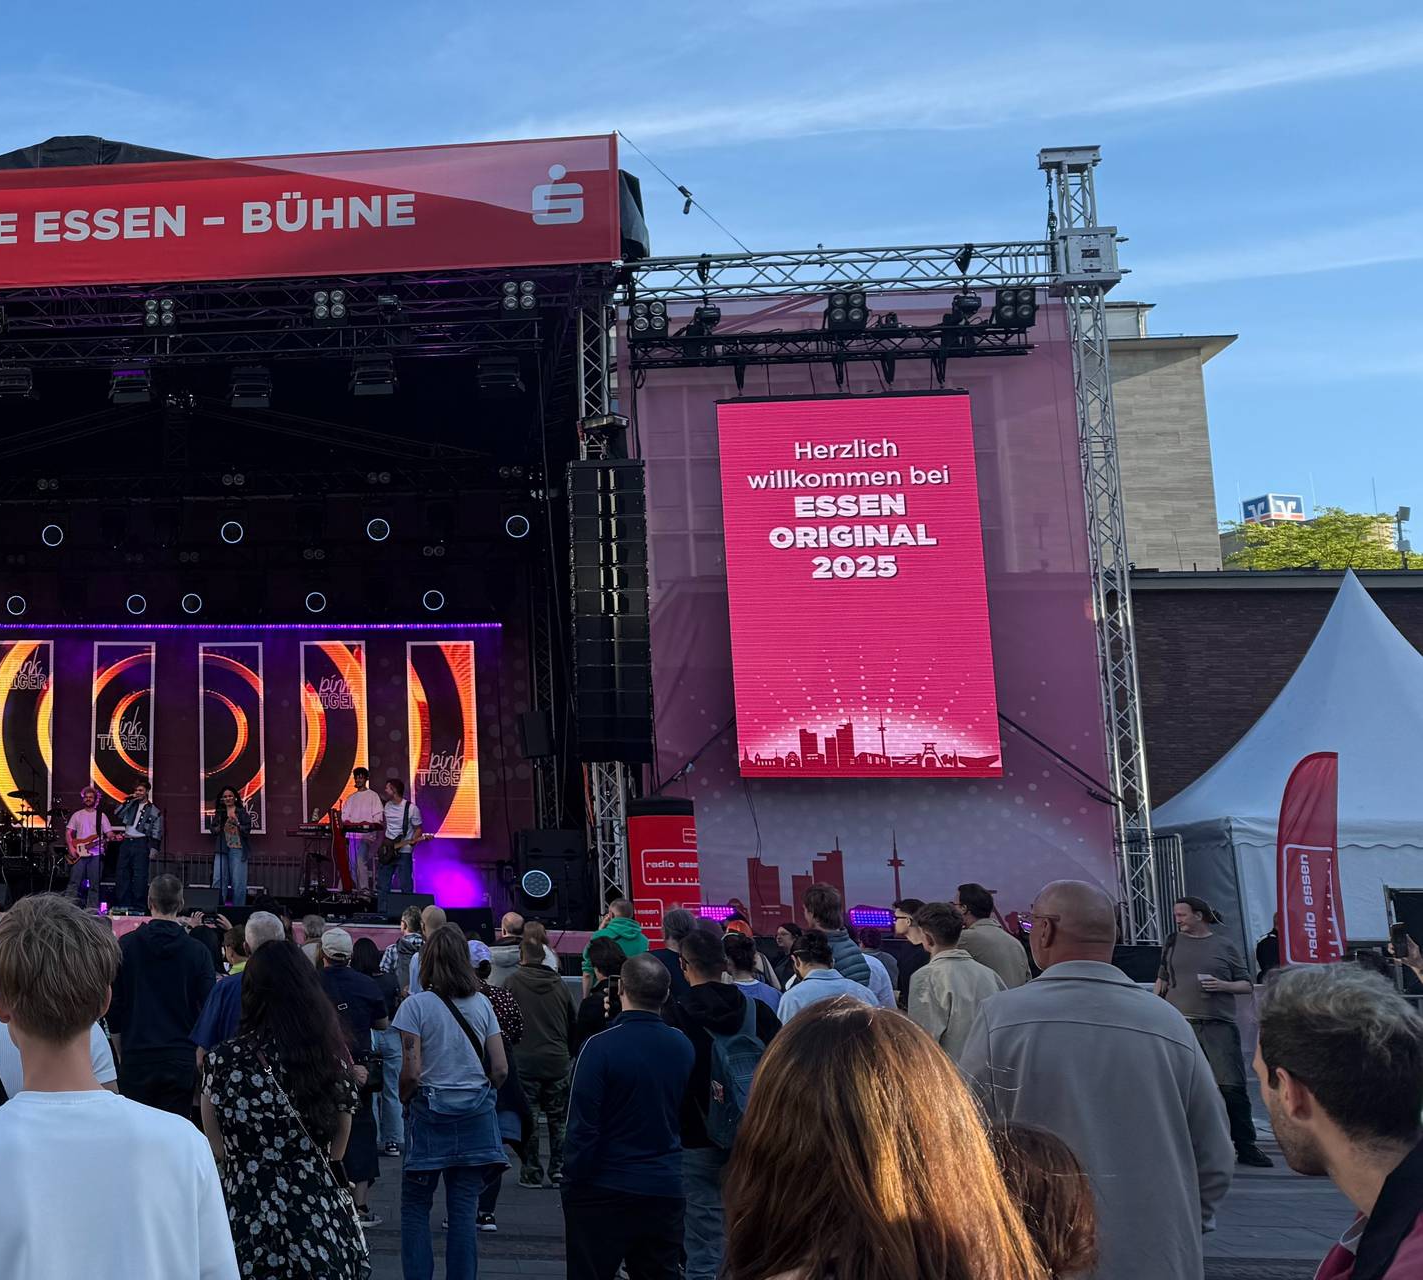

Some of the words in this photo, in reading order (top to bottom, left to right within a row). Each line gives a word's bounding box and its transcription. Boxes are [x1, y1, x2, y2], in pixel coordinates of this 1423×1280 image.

[33, 205, 185, 243] ESSEN
[242, 191, 416, 234] BÜHNE
[794, 438, 899, 460] Herzlich
[747, 469, 902, 489] willkommen
[910, 465, 950, 485] bei
[794, 493, 907, 519] ESSEN
[768, 523, 938, 550] ORIGINAL
[811, 555, 899, 579] 2025
[1299, 854, 1313, 906] essen
[1304, 912, 1318, 959] radio
